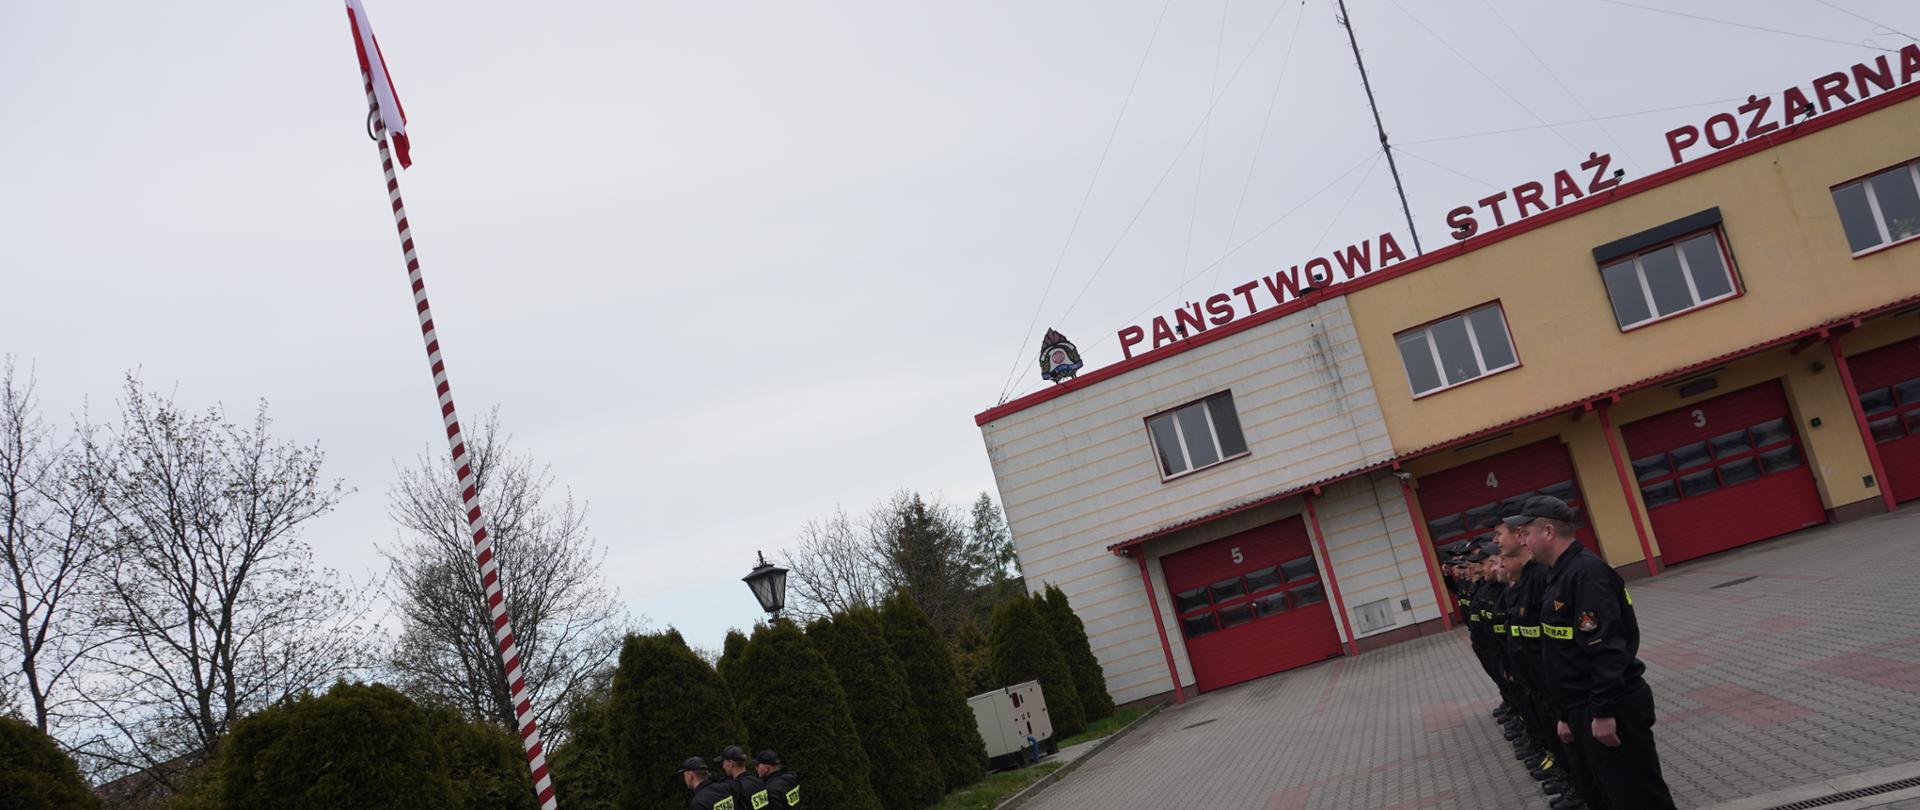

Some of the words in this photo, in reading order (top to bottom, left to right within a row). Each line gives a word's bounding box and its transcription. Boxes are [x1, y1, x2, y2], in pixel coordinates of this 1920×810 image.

[1117, 232, 1406, 360] PAŃSTWOWA
[1446, 152, 1619, 240] STRAŻ
[1665, 43, 1920, 165] POŻARNA
[1691, 409, 1706, 427] 3
[1486, 471, 1499, 488] 4
[1231, 546, 1244, 564] 5
